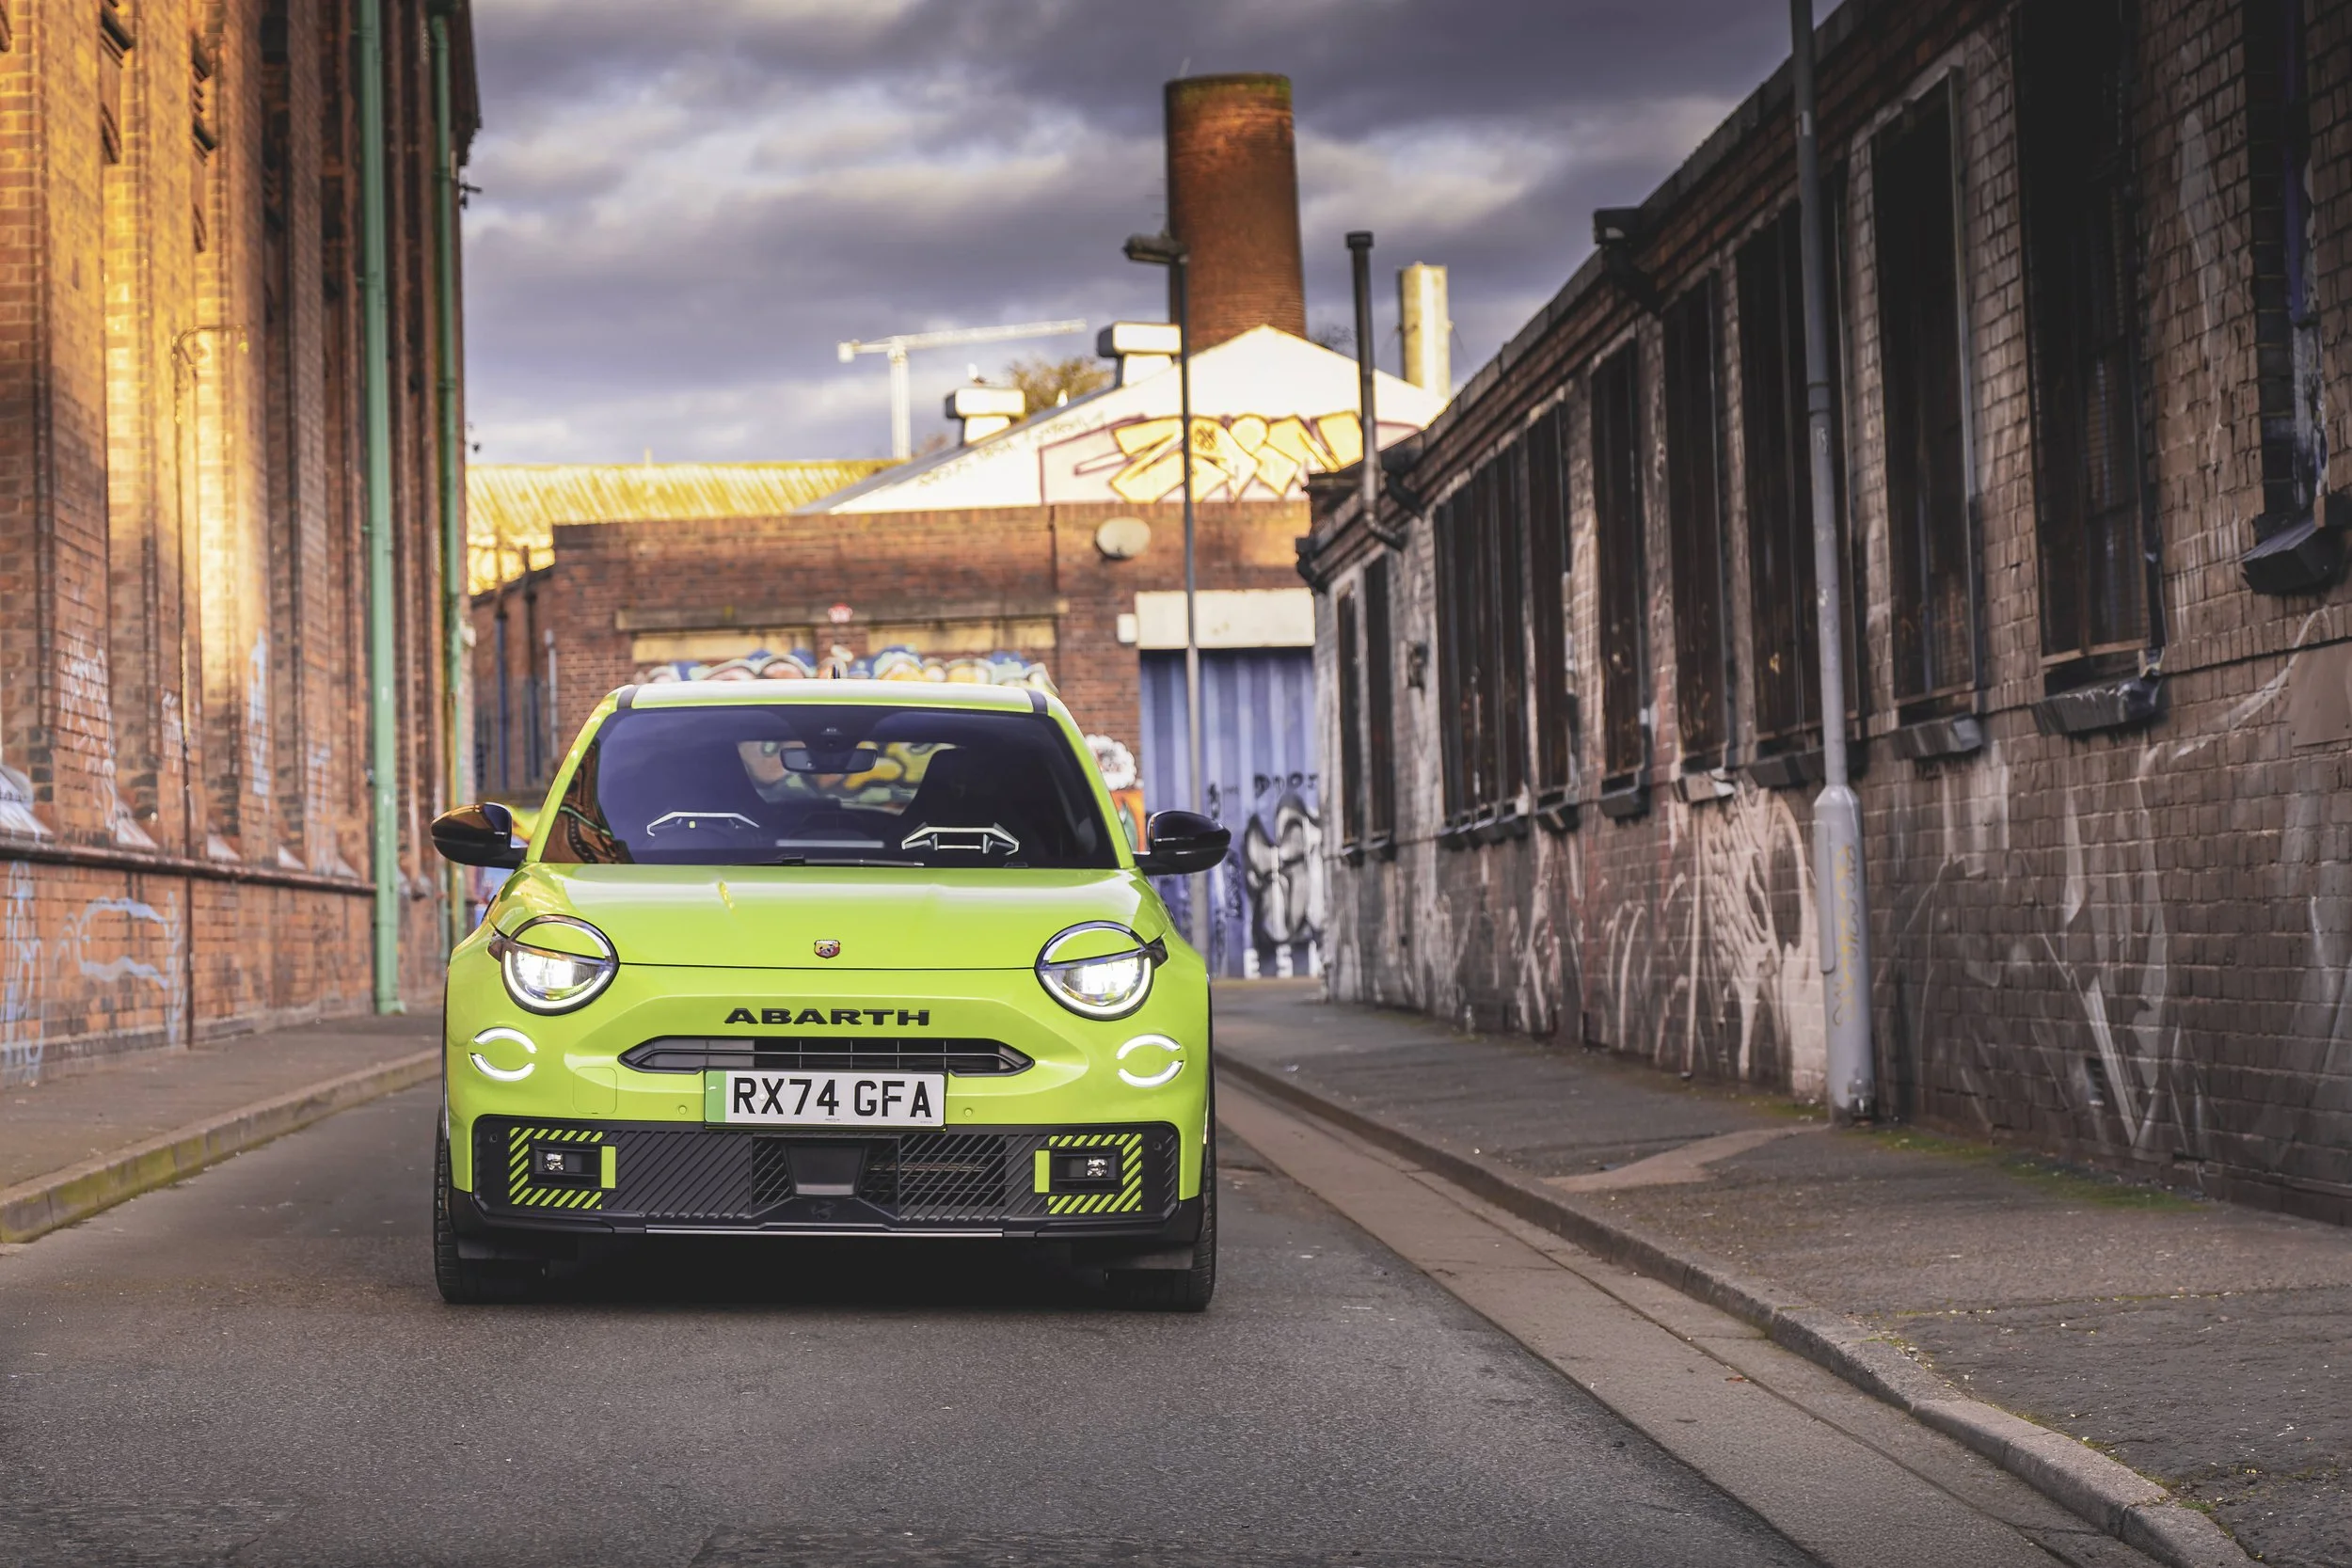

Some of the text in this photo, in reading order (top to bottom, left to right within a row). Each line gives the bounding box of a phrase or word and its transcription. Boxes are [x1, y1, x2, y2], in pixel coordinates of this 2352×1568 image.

[723, 1007, 930, 1026] ABARTH
[733, 1077, 932, 1118] RX74 GFA
